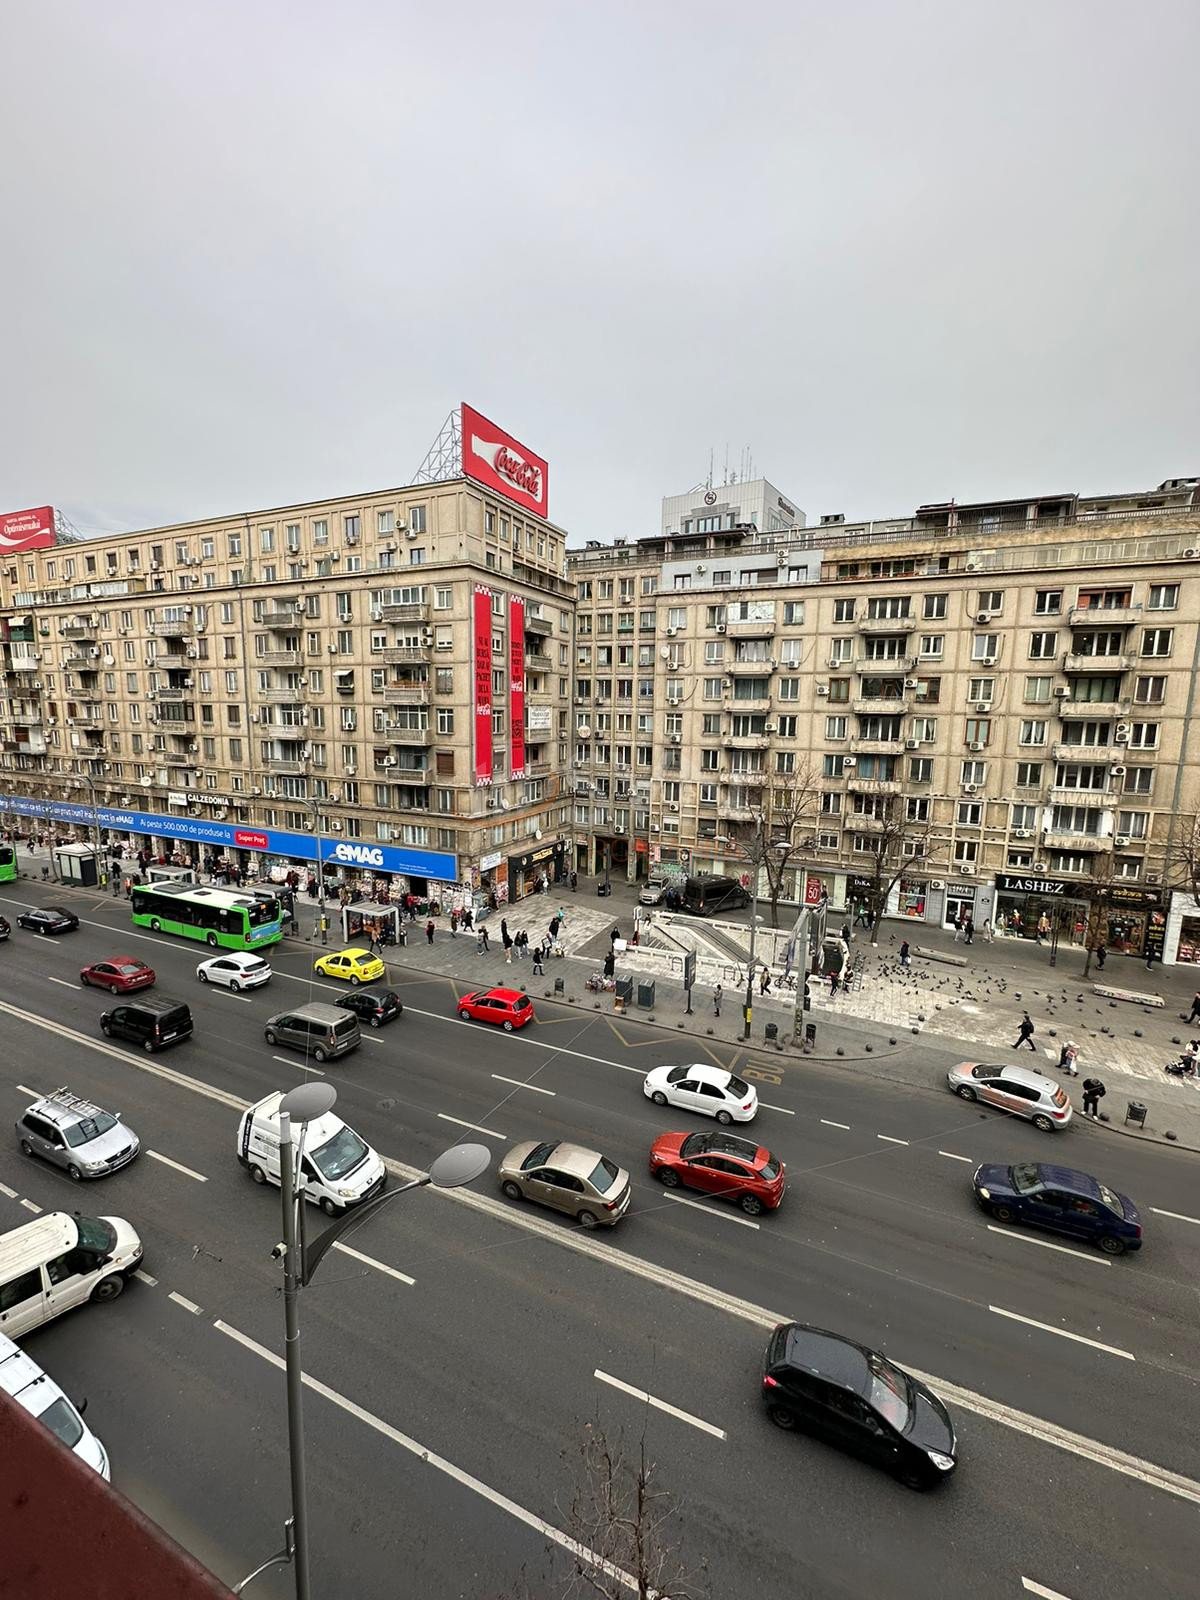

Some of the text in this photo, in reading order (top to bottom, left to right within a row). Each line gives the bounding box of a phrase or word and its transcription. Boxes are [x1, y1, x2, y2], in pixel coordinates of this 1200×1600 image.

[187, 794, 230, 806] CALZEDONIA
[140, 818, 231, 839] Ai peste 500.000 de produse la
[238, 834, 253, 843] Super
[335, 843, 384, 866] eMAG
[1004, 877, 1065, 895] LASHEZ
